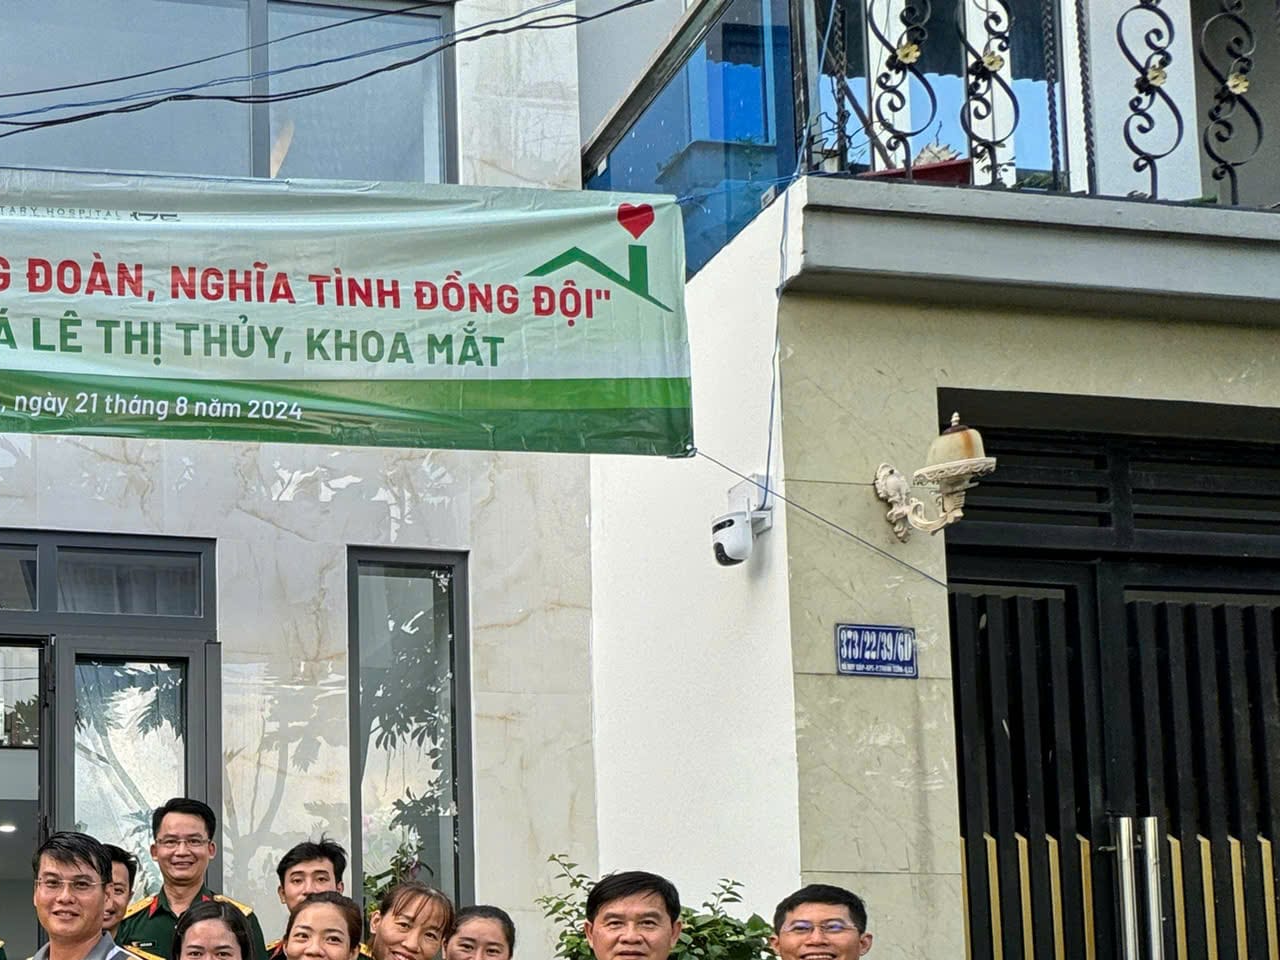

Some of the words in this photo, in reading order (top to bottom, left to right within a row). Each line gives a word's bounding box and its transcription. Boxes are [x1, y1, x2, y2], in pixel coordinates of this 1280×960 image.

[26, 252, 156, 303] ĐOÀN,
[170, 261, 296, 304] NGHĨA
[308, 267, 400, 309] TÌNH
[414, 270, 519, 315] ĐỒNG
[532, 279, 611, 327] ĐỘI"
[32, 310, 83, 353] LÊ
[96, 320, 162, 366] THỊ
[175, 314, 292, 364] THỦY,
[307, 327, 414, 364] KHOA
[427, 320, 505, 367] MẮT
[14, 392, 69, 417] ngày
[74, 392, 98, 413] 21
[104, 394, 170, 420] tháng
[175, 396, 188, 416] 8
[194, 398, 241, 418] năm
[247, 400, 303, 420] 2024
